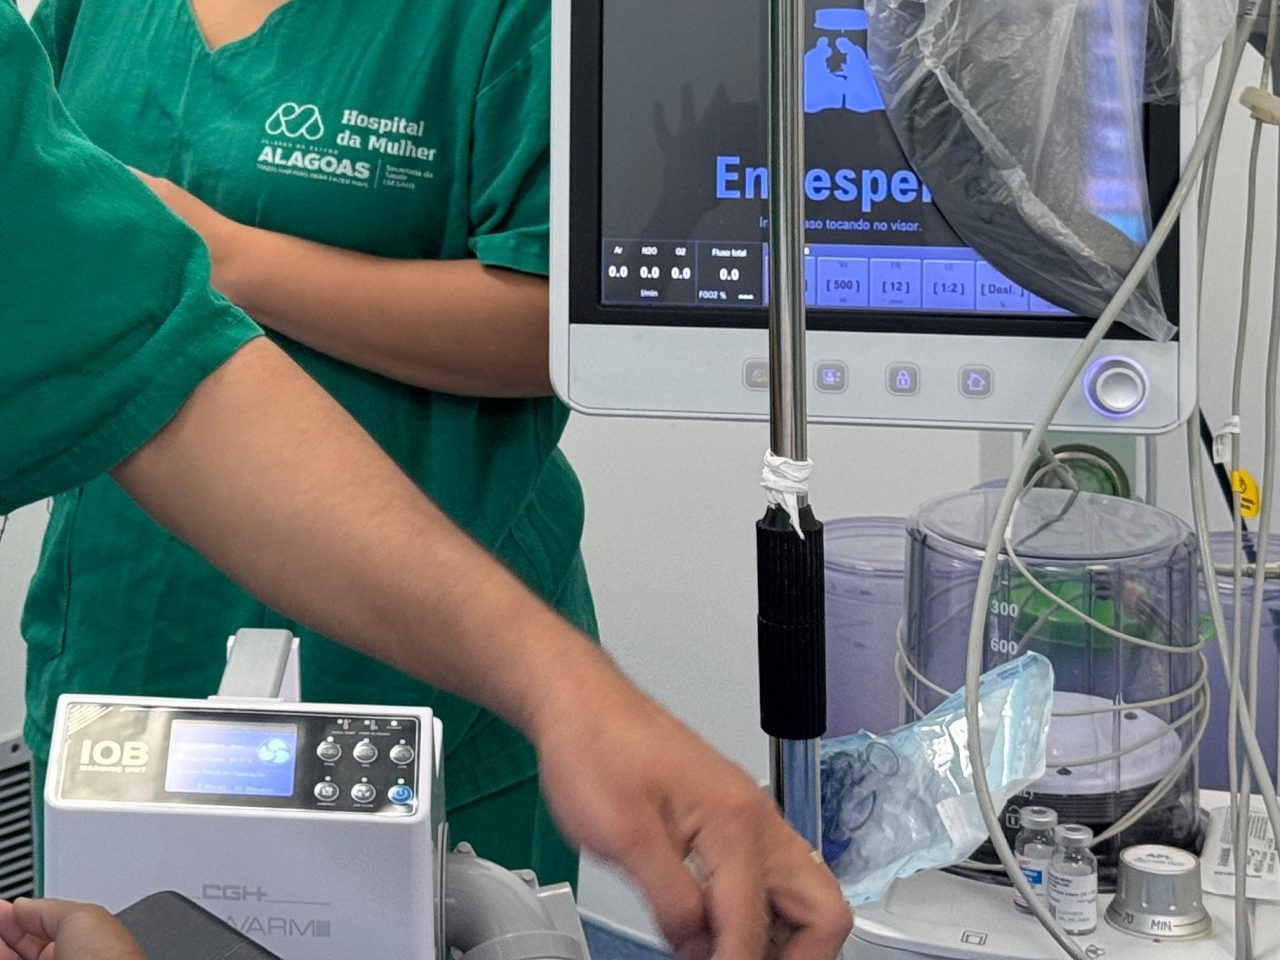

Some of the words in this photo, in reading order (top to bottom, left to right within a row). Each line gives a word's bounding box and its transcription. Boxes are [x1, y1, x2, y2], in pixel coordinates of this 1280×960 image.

[341, 109, 424, 137] Hospital
[336, 130, 361, 148] da
[368, 134, 436, 162] Mulher
[258, 145, 371, 180] ALAGOAS
[804, 220, 822, 229] aso
[826, 218, 870, 230] tocando
[873, 222, 888, 230] no
[608, 266, 628, 278] 0.0
[640, 266, 660, 278] 0.0
[671, 267, 691, 280] 0.0
[720, 268, 740, 280] 0.0
[990, 600, 1018, 618] 300
[990, 638, 1018, 654] 600
[80, 739, 150, 767] IOB
[202, 884, 268, 902] CGH
[1150, 919, 1172, 931] MIN
